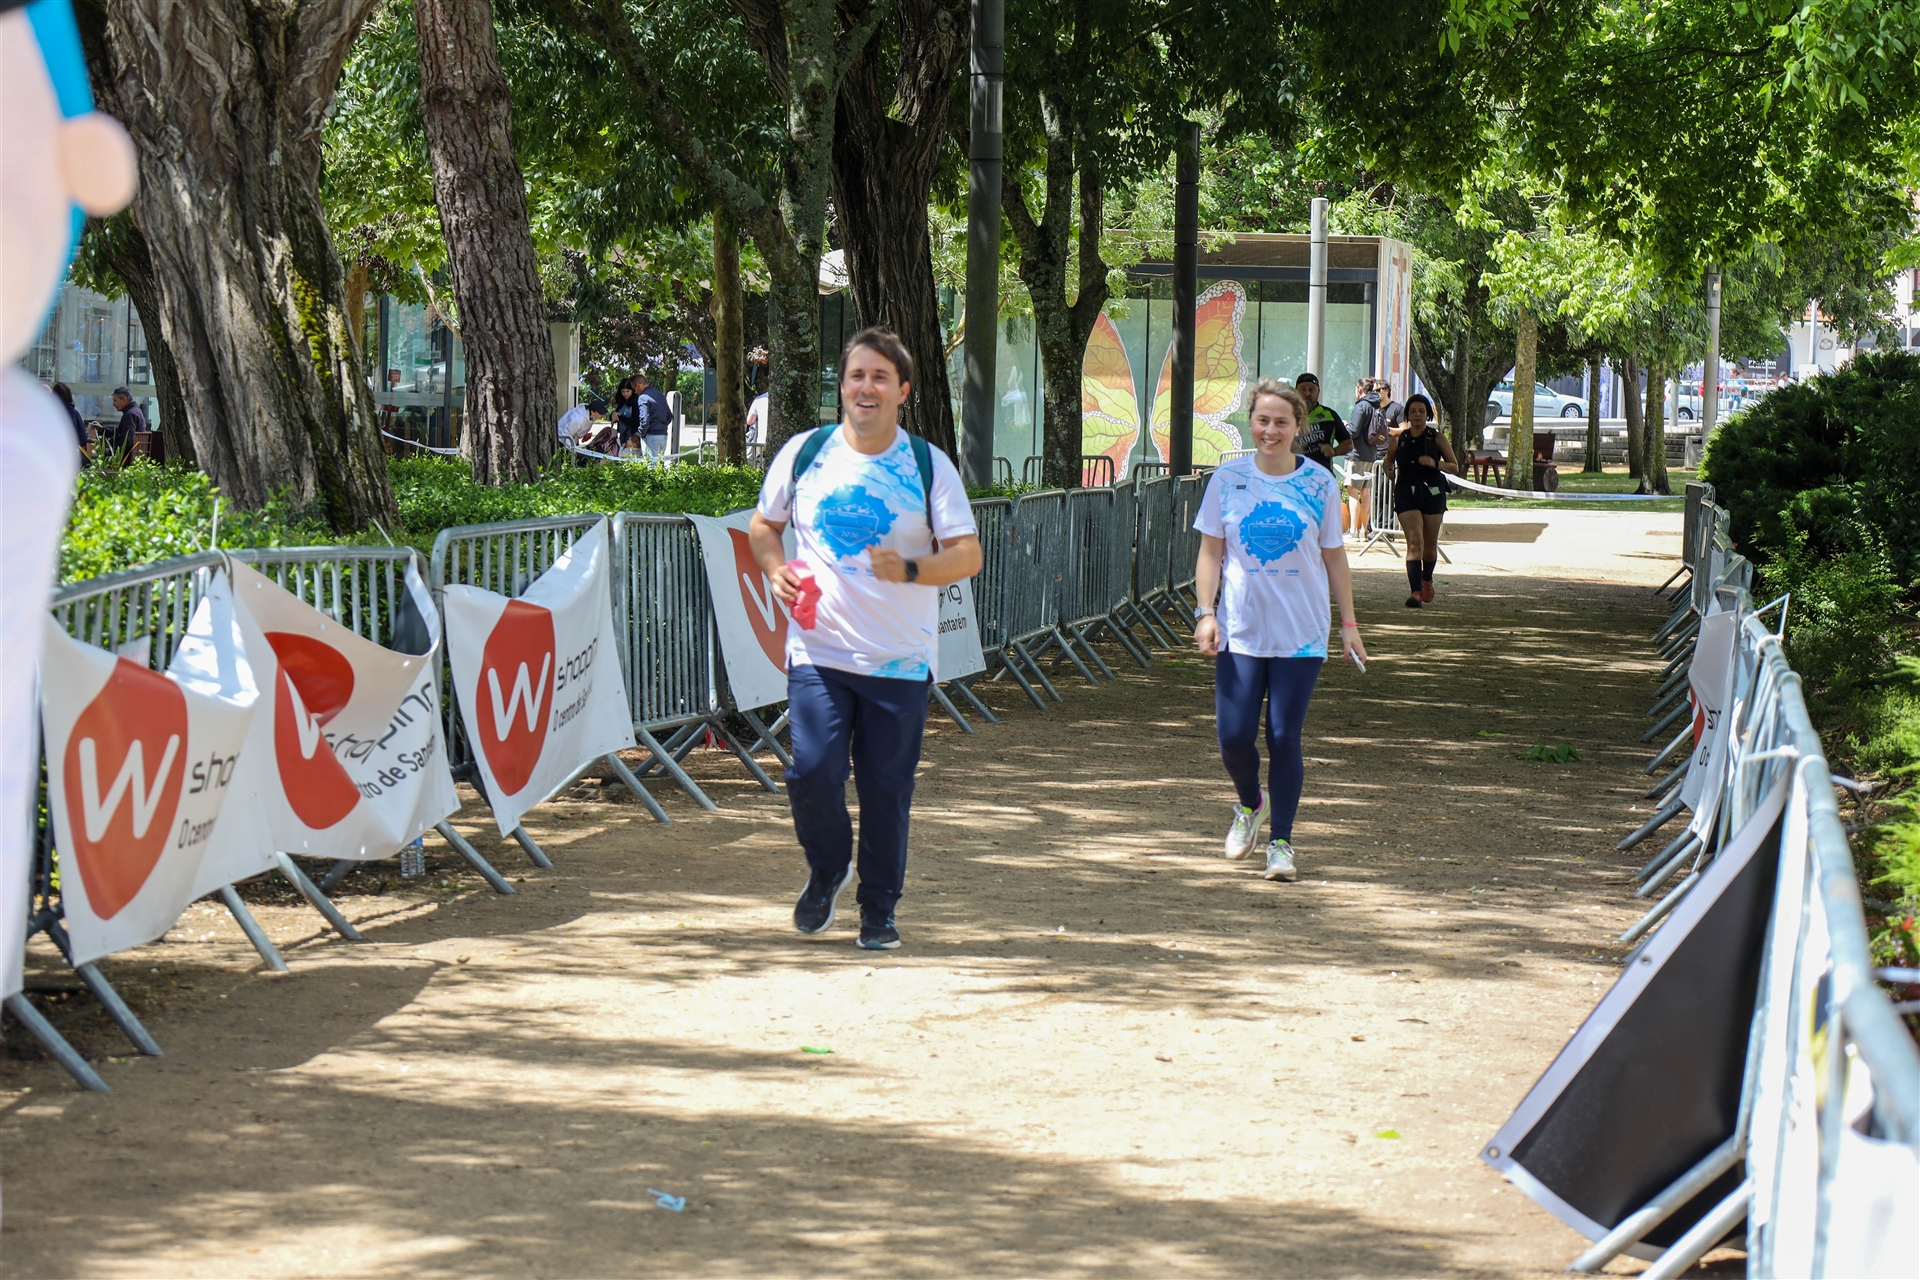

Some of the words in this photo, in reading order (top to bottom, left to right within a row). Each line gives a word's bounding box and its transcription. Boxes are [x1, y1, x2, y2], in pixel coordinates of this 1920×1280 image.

[488, 652, 551, 741] W
[79, 734, 180, 843] W
[377, 766, 407, 787] de
